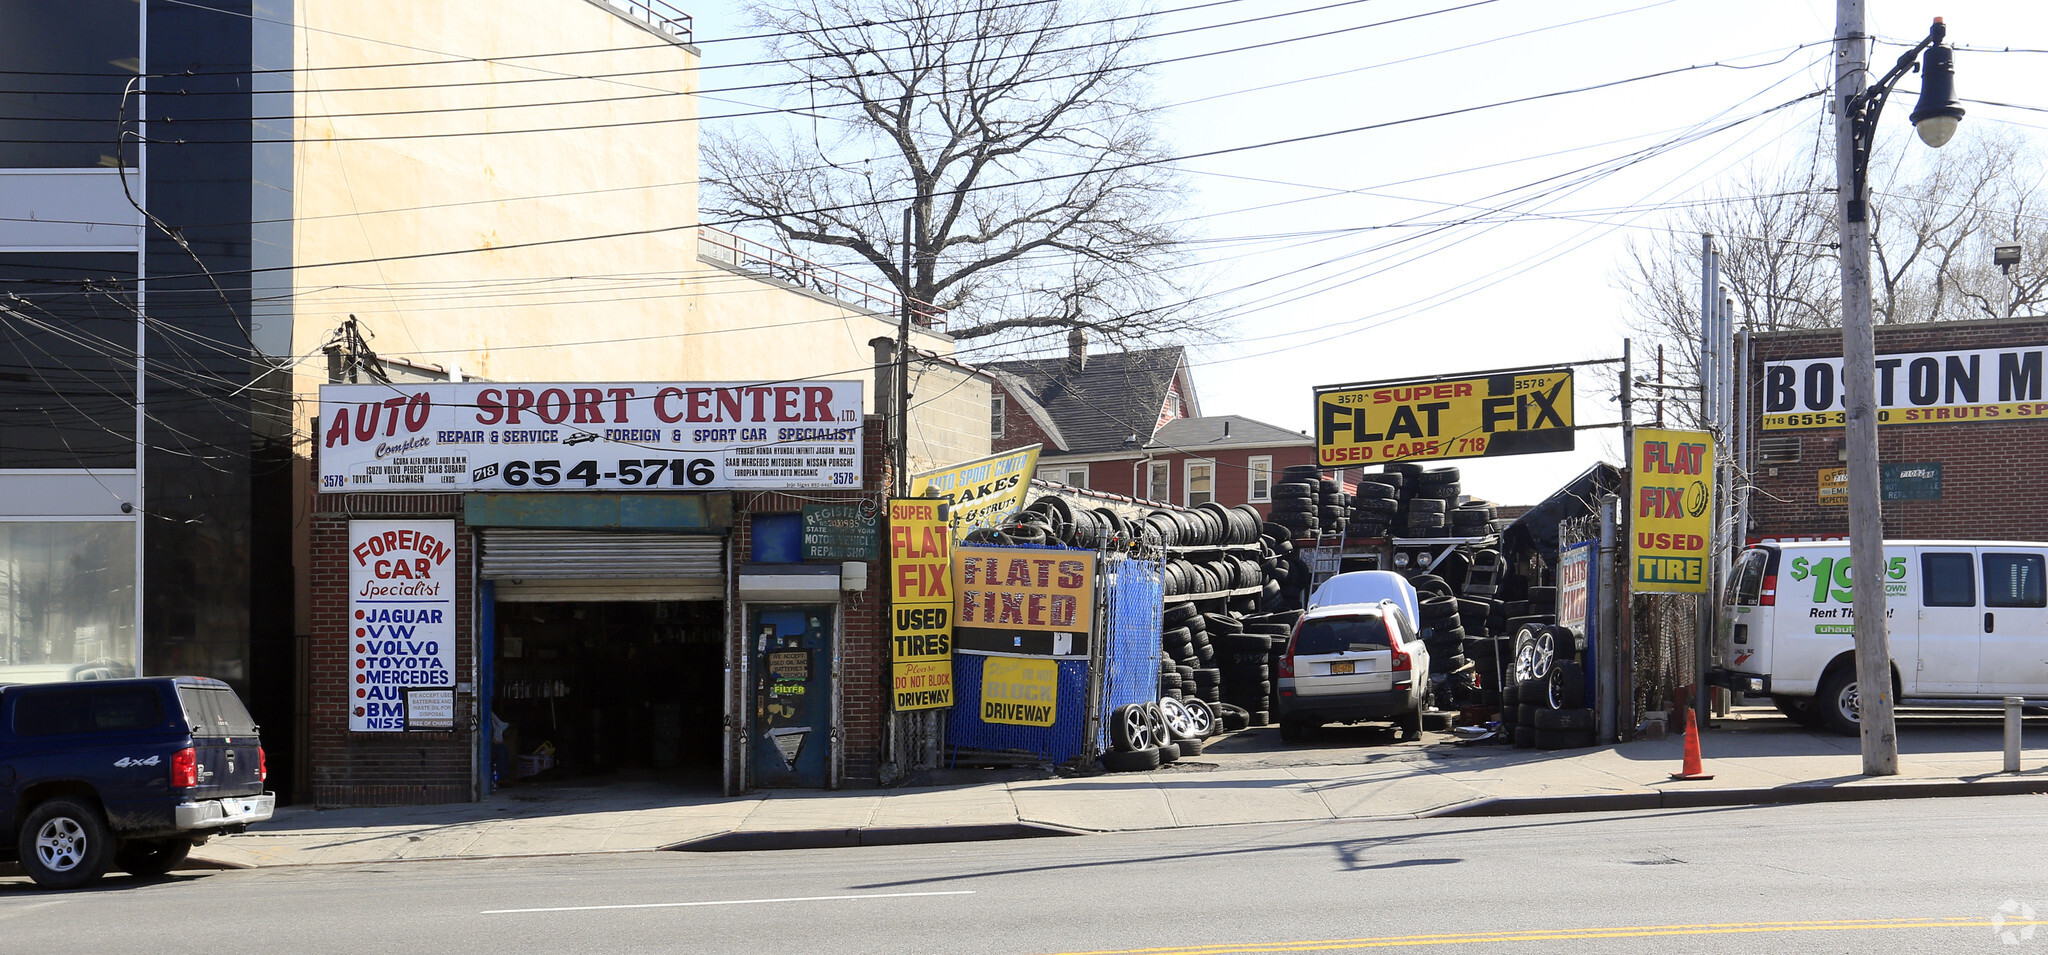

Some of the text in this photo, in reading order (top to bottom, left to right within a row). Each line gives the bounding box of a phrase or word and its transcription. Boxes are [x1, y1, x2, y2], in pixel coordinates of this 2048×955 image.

[1766, 351, 2043, 413] BOTON M
[1373, 383, 1473, 405] SUPER
[476, 388, 635, 425] SPORT
[1322, 373, 1571, 446] FLAT FIX
[325, 391, 430, 448] AUTO
[1765, 417, 1785, 425] 718
[1788, 410, 1890, 426] 655-30
[1905, 405, 1999, 421] STRUTS
[437, 427, 856, 444] REPAIR & SERVICE FOREIGN & SPORT CAR SPECIALIST
[374, 436, 431, 460] Complete
[756, 447, 772, 455] HONDA
[773, 447, 795, 455] HYUNDAI
[795, 447, 815, 455] INFINITI
[816, 447, 835, 455] JAGUAR
[839, 447, 855, 455] MAZDA
[1322, 446, 1373, 463] USED
[1382, 440, 1440, 459] CARS
[1459, 438, 1486, 453] 718
[393, 457, 409, 465] ACURA
[725, 458, 853, 467] SAAB MERCEDES MITSUBISHI NISSAN PORSCHE
[1642, 441, 1707, 476] FLAT
[366, 465, 466, 475] ISUZU VOLVO PEUGEOT SAAB SUBARU
[474, 464, 497, 481] 718
[503, 458, 716, 488] 654-5716
[734, 468, 818, 477] EUROPEAN TRAINED AUTO MECHANIC
[833, 472, 854, 485] 3578
[959, 463, 992, 487] SPORT
[994, 454, 1028, 477] CENTER
[1824, 470, 1848, 482] OFFI
[324, 475, 344, 488] 3578
[352, 474, 455, 484] TOYOTA VOLKSWAGEN LEXUS
[938, 473, 1020, 506] RAKES
[1639, 486, 1686, 519] FIX
[1820, 496, 1848, 504] INSPECTIO
[892, 505, 933, 521] SUPER
[965, 506, 978, 523] &
[979, 496, 1017, 517] STRUTS
[805, 533, 835, 545] MOTOR
[891, 525, 948, 559] FLAT
[1637, 532, 1704, 551] USED
[352, 530, 452, 567] FOREIGN
[810, 546, 843, 557] REPAIR
[374, 558, 432, 580] CAR
[964, 556, 1085, 589] FLATS
[1638, 557, 1701, 582] TIRE
[897, 563, 948, 598] FIX
[359, 580, 440, 600] Specialist
[366, 609, 443, 624] JAGUAR
[962, 590, 1077, 627] FIXED
[1809, 608, 1838, 619] Rent
[1841, 608, 1855, 619] Th
[896, 607, 948, 631] USED
[366, 625, 416, 639] VW
[1820, 625, 1856, 634] uhaul.
[366, 641, 439, 656] VOLVO
[894, 633, 950, 657] TIRES
[366, 657, 443, 669] TOYOTA
[904, 663, 936, 677] Please
[366, 670, 449, 685] MERCEDES
[895, 673, 950, 690] DO NOT BLOCK
[366, 686, 404, 700] AU
[774, 685, 806, 694] FILTER
[986, 681, 1053, 702] BLOCK
[898, 689, 950, 708] DRIVEWAY
[366, 702, 404, 717] BM
[985, 702, 1052, 722] DRIVEWAY
[366, 718, 404, 729] NISS
[113, 755, 161, 768] 4x4
